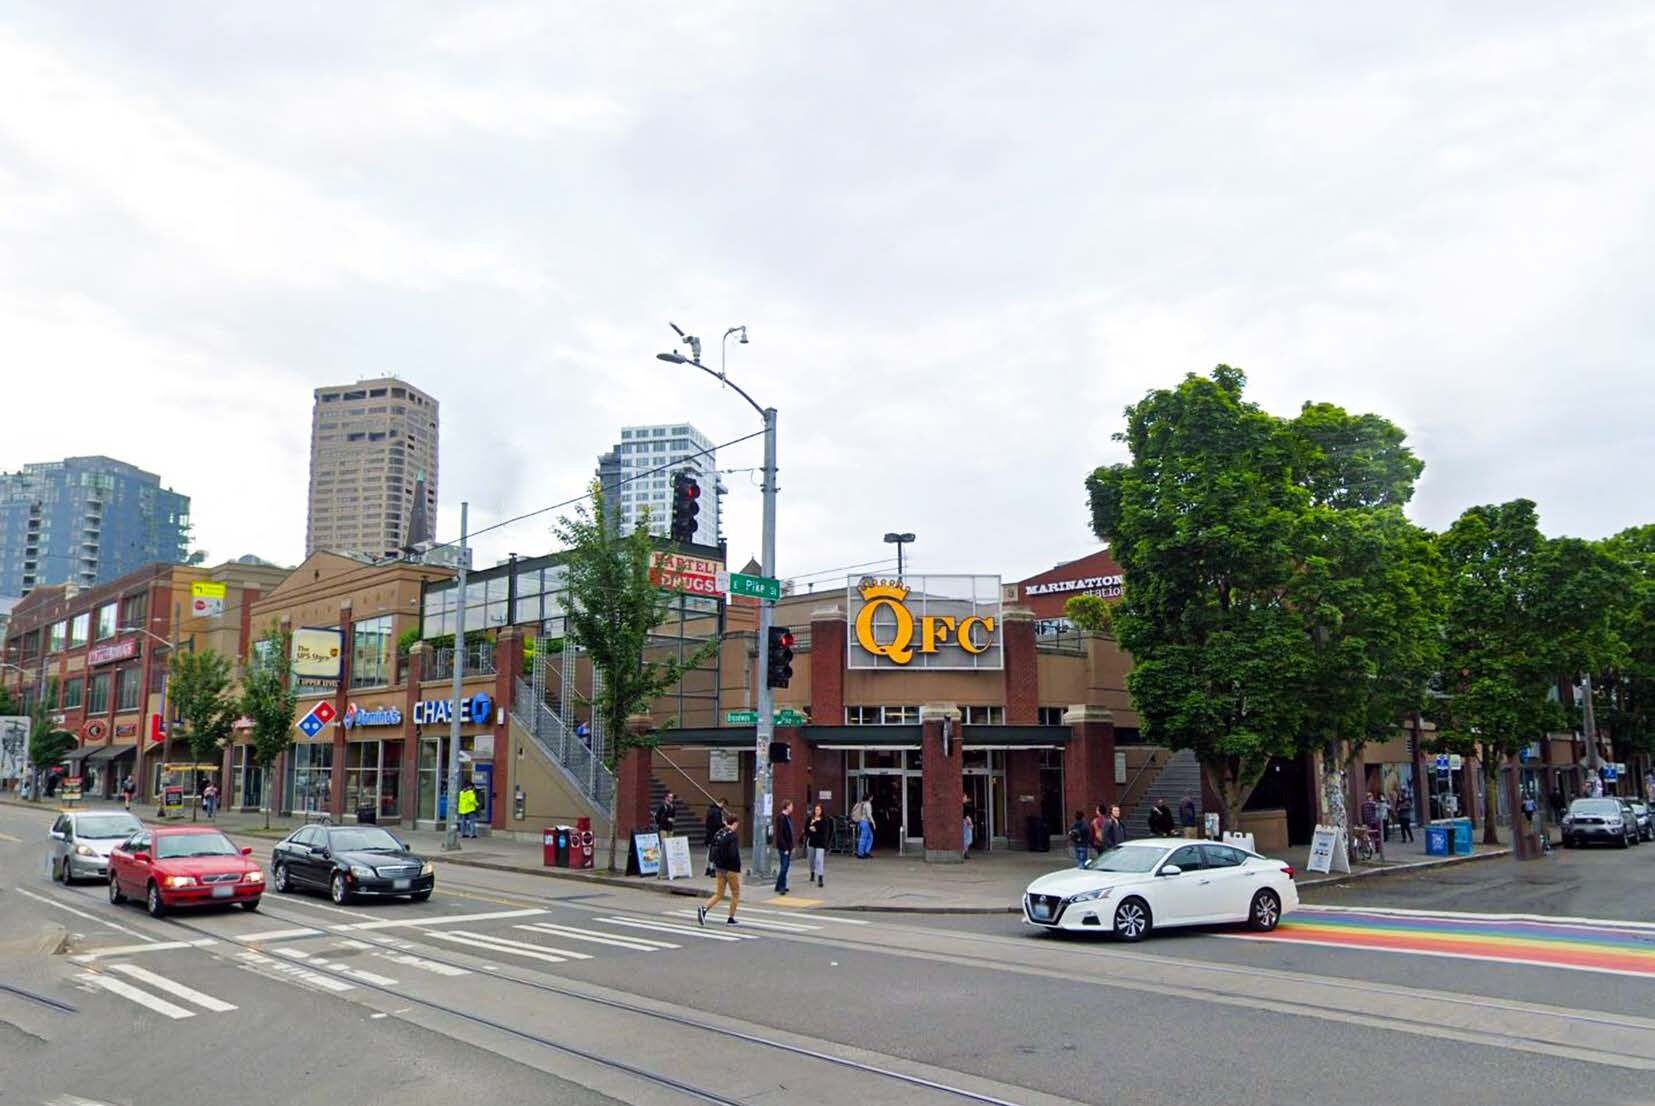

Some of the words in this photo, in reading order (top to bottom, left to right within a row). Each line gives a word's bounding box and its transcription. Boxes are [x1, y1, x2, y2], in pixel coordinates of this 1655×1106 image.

[661, 574, 714, 593] DRUGS
[745, 579, 765, 593] Pike
[1025, 575, 1124, 595] MARINATION
[855, 599, 995, 665] QFC
